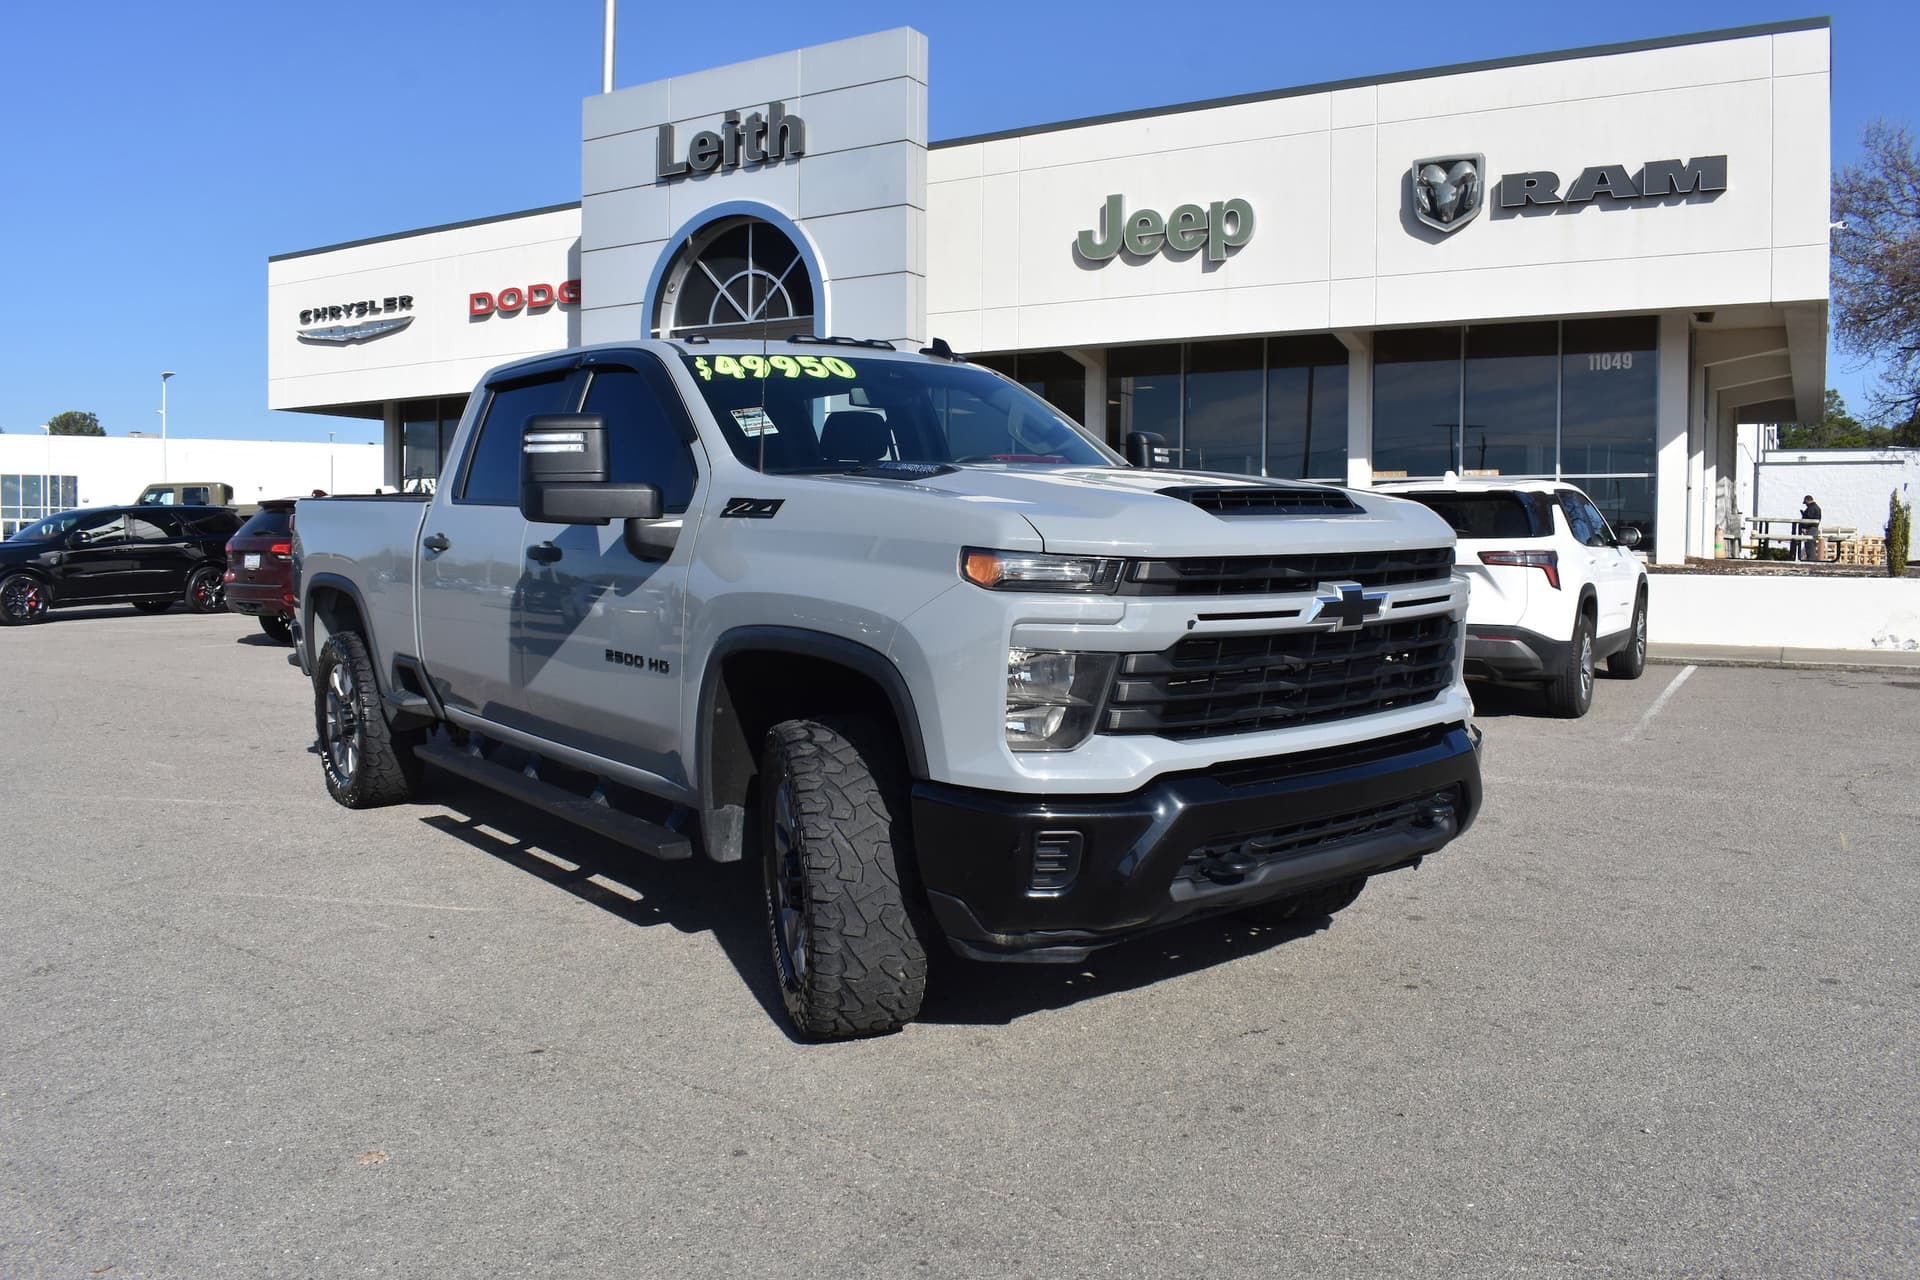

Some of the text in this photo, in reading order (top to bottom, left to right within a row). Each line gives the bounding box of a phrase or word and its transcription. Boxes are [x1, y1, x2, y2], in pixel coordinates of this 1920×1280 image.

[657, 101, 805, 177] Leith
[1500, 154, 1728, 208] RAM
[1077, 193, 1256, 261] Jeep
[299, 295, 414, 325] CHRYSLER
[469, 278, 581, 316] DODG
[695, 355, 857, 381] $49950
[1587, 351, 1632, 371] 11049
[605, 649, 670, 674] 2500 HD
